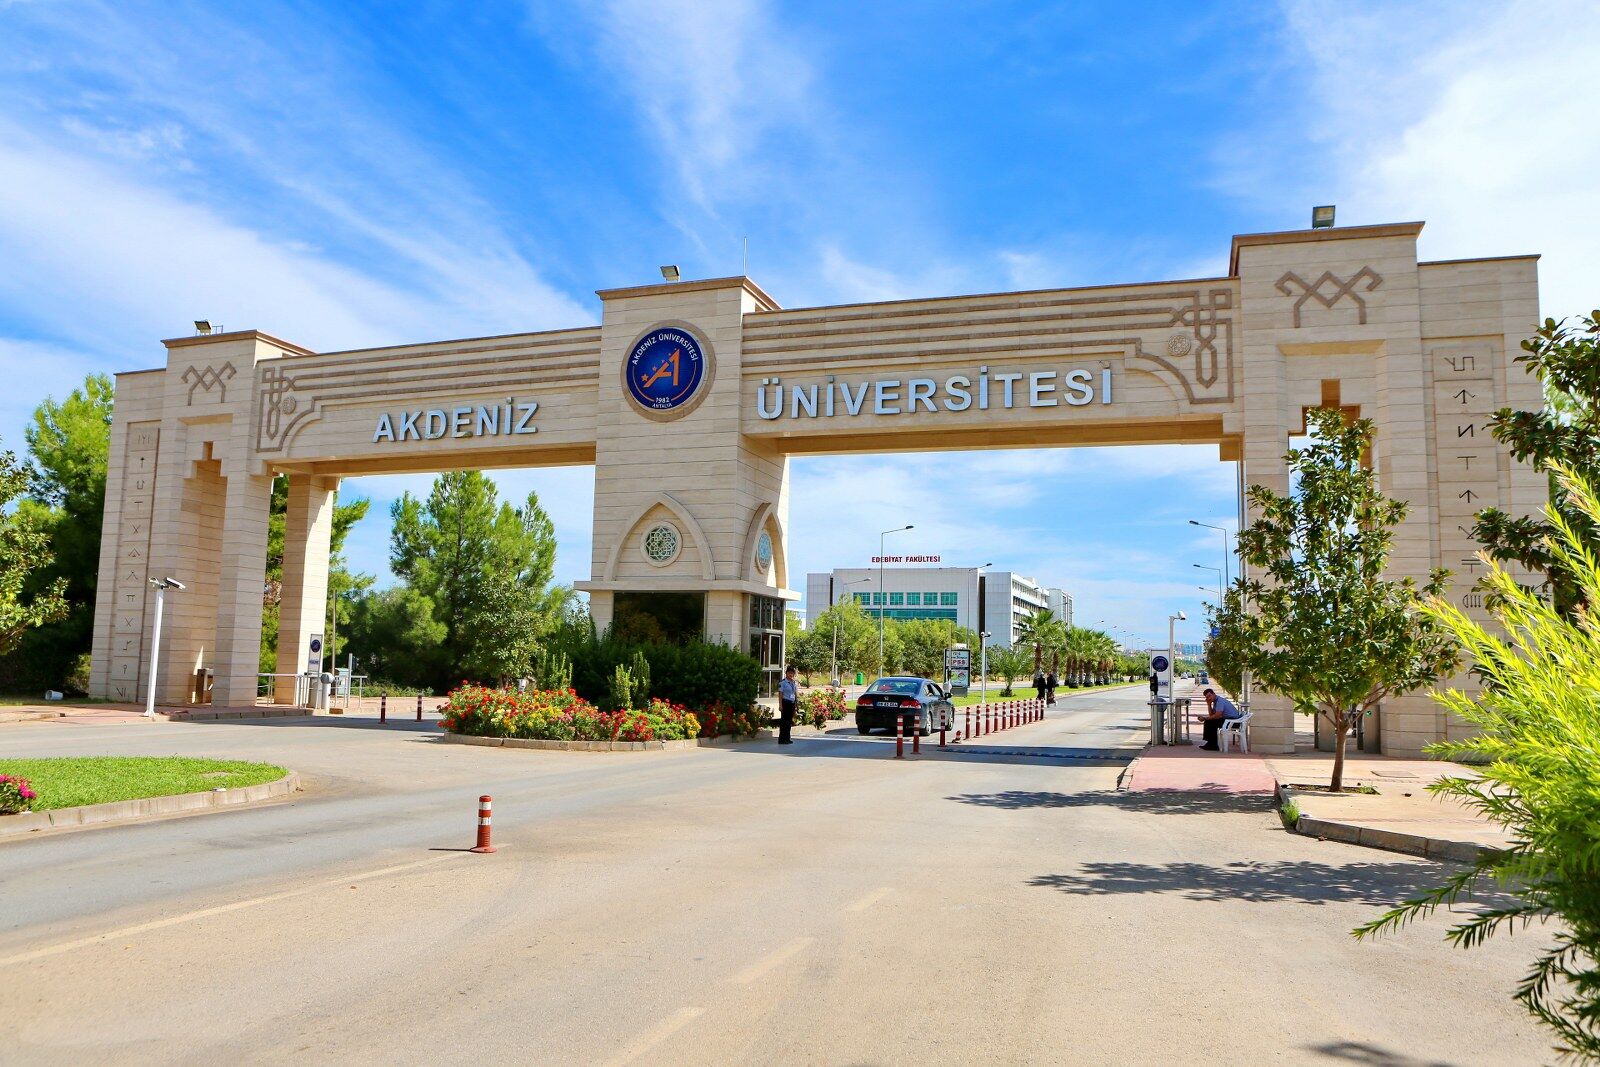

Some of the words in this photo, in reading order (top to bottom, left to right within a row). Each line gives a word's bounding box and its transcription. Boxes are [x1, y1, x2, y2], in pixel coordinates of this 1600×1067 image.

[632, 336, 657, 366] AKDENİZ
[658, 333, 699, 361] ÜNİVERSİTESİ
[372, 396, 539, 444] AKDENİZ
[757, 361, 1113, 421] ÜNİVERSİTESİ
[655, 396, 670, 404] 1982
[871, 555, 903, 563] EDEBİYAT
[905, 554, 941, 563] FAKÜLTESİ
